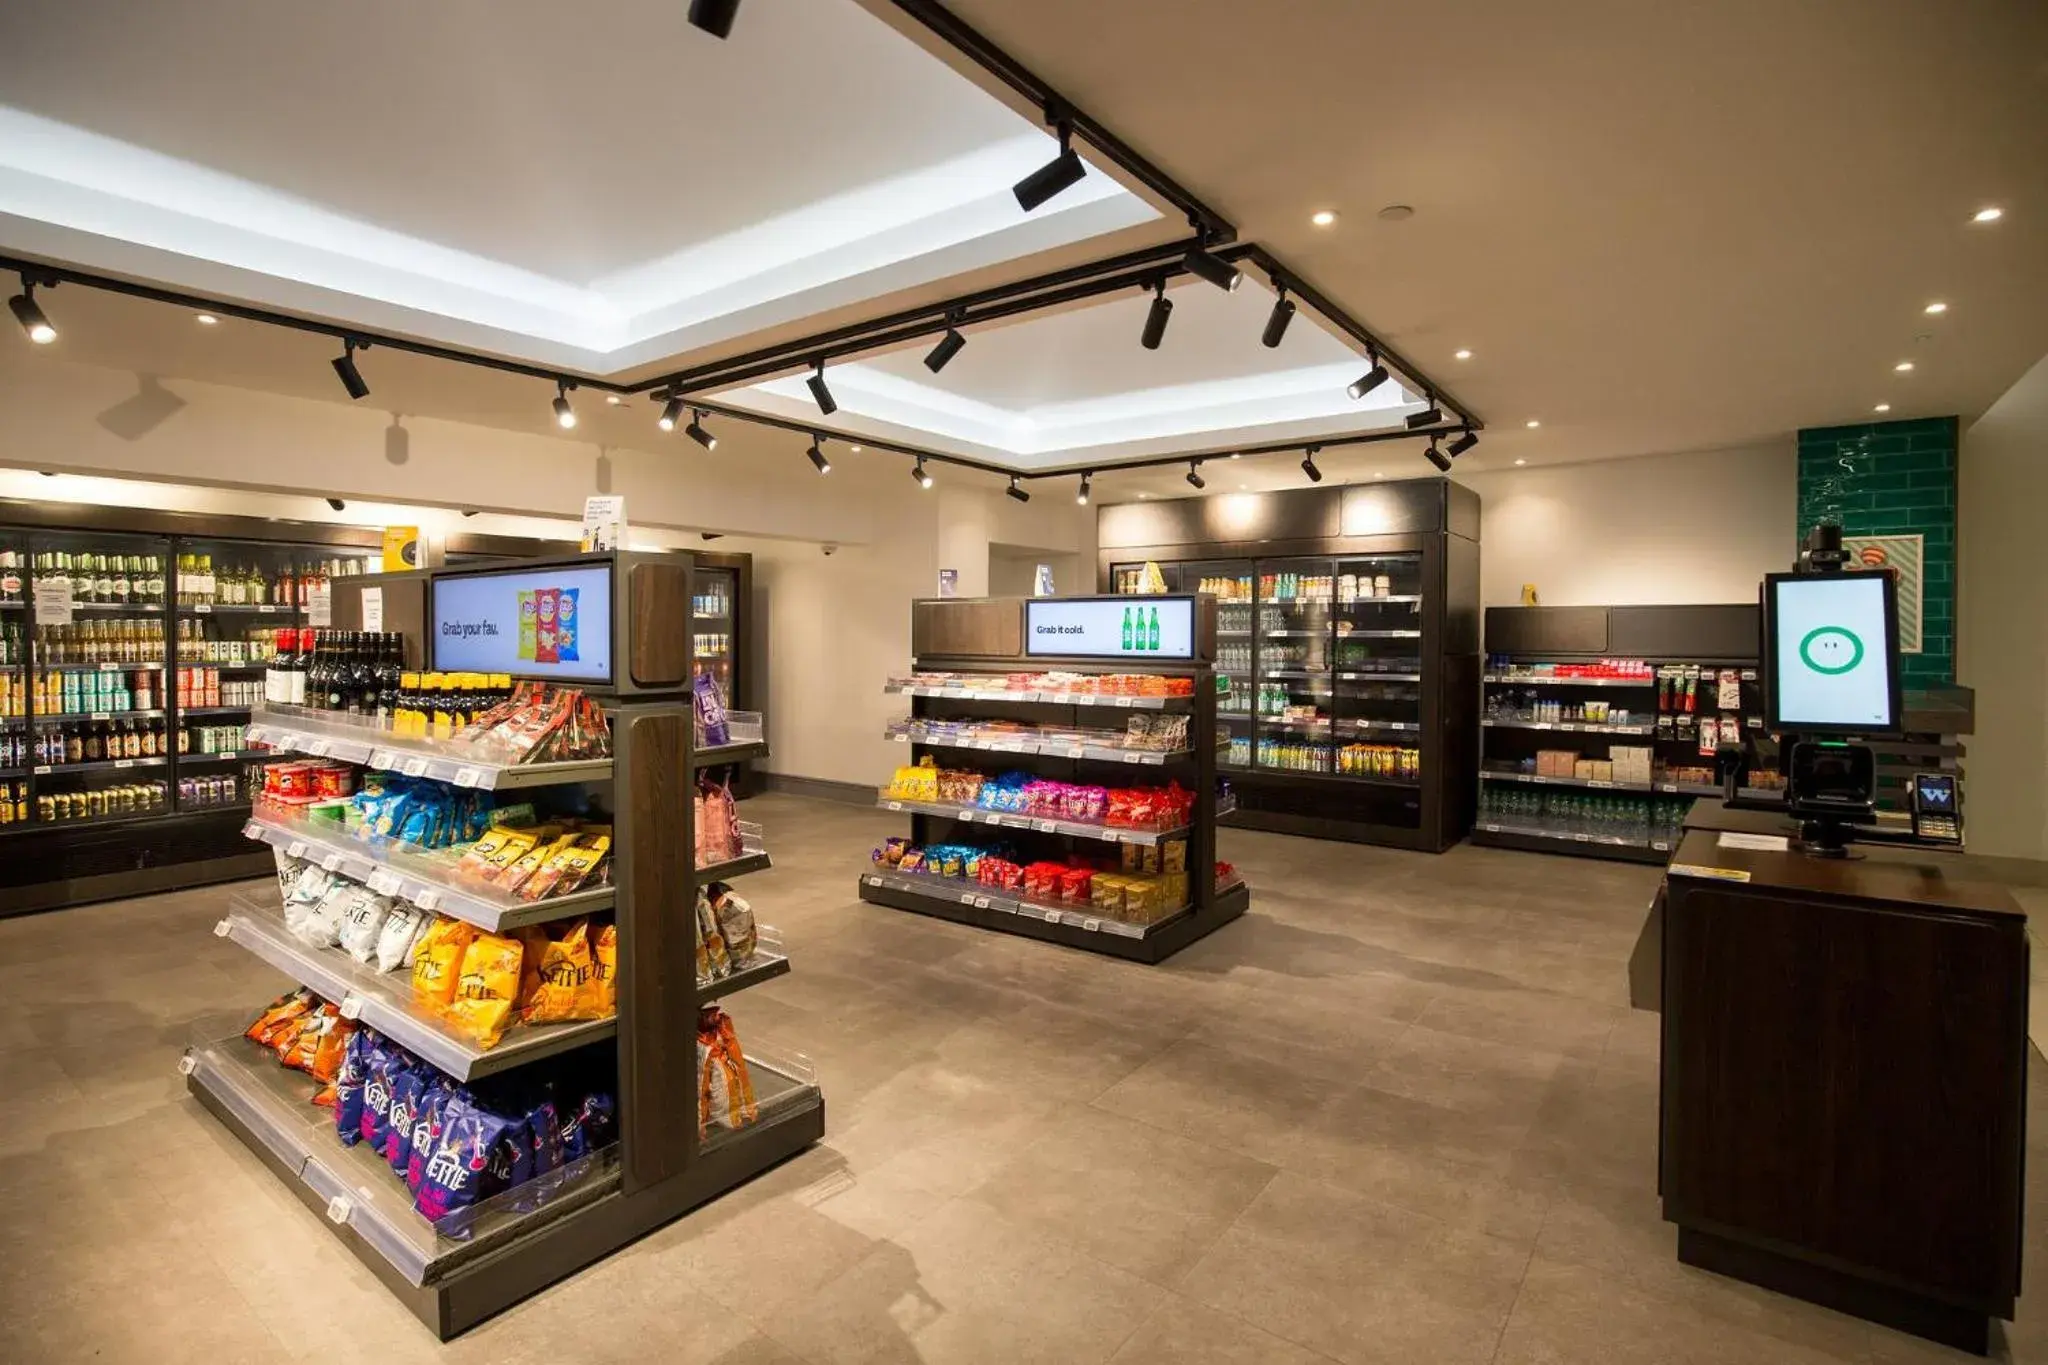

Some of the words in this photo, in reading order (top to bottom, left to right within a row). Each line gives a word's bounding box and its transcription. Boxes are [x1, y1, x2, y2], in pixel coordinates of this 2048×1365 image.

[441, 619, 462, 637] Grab
[462, 623, 482, 640] your
[1036, 624, 1057, 635] Grab
[1064, 624, 1085, 635] cold.
